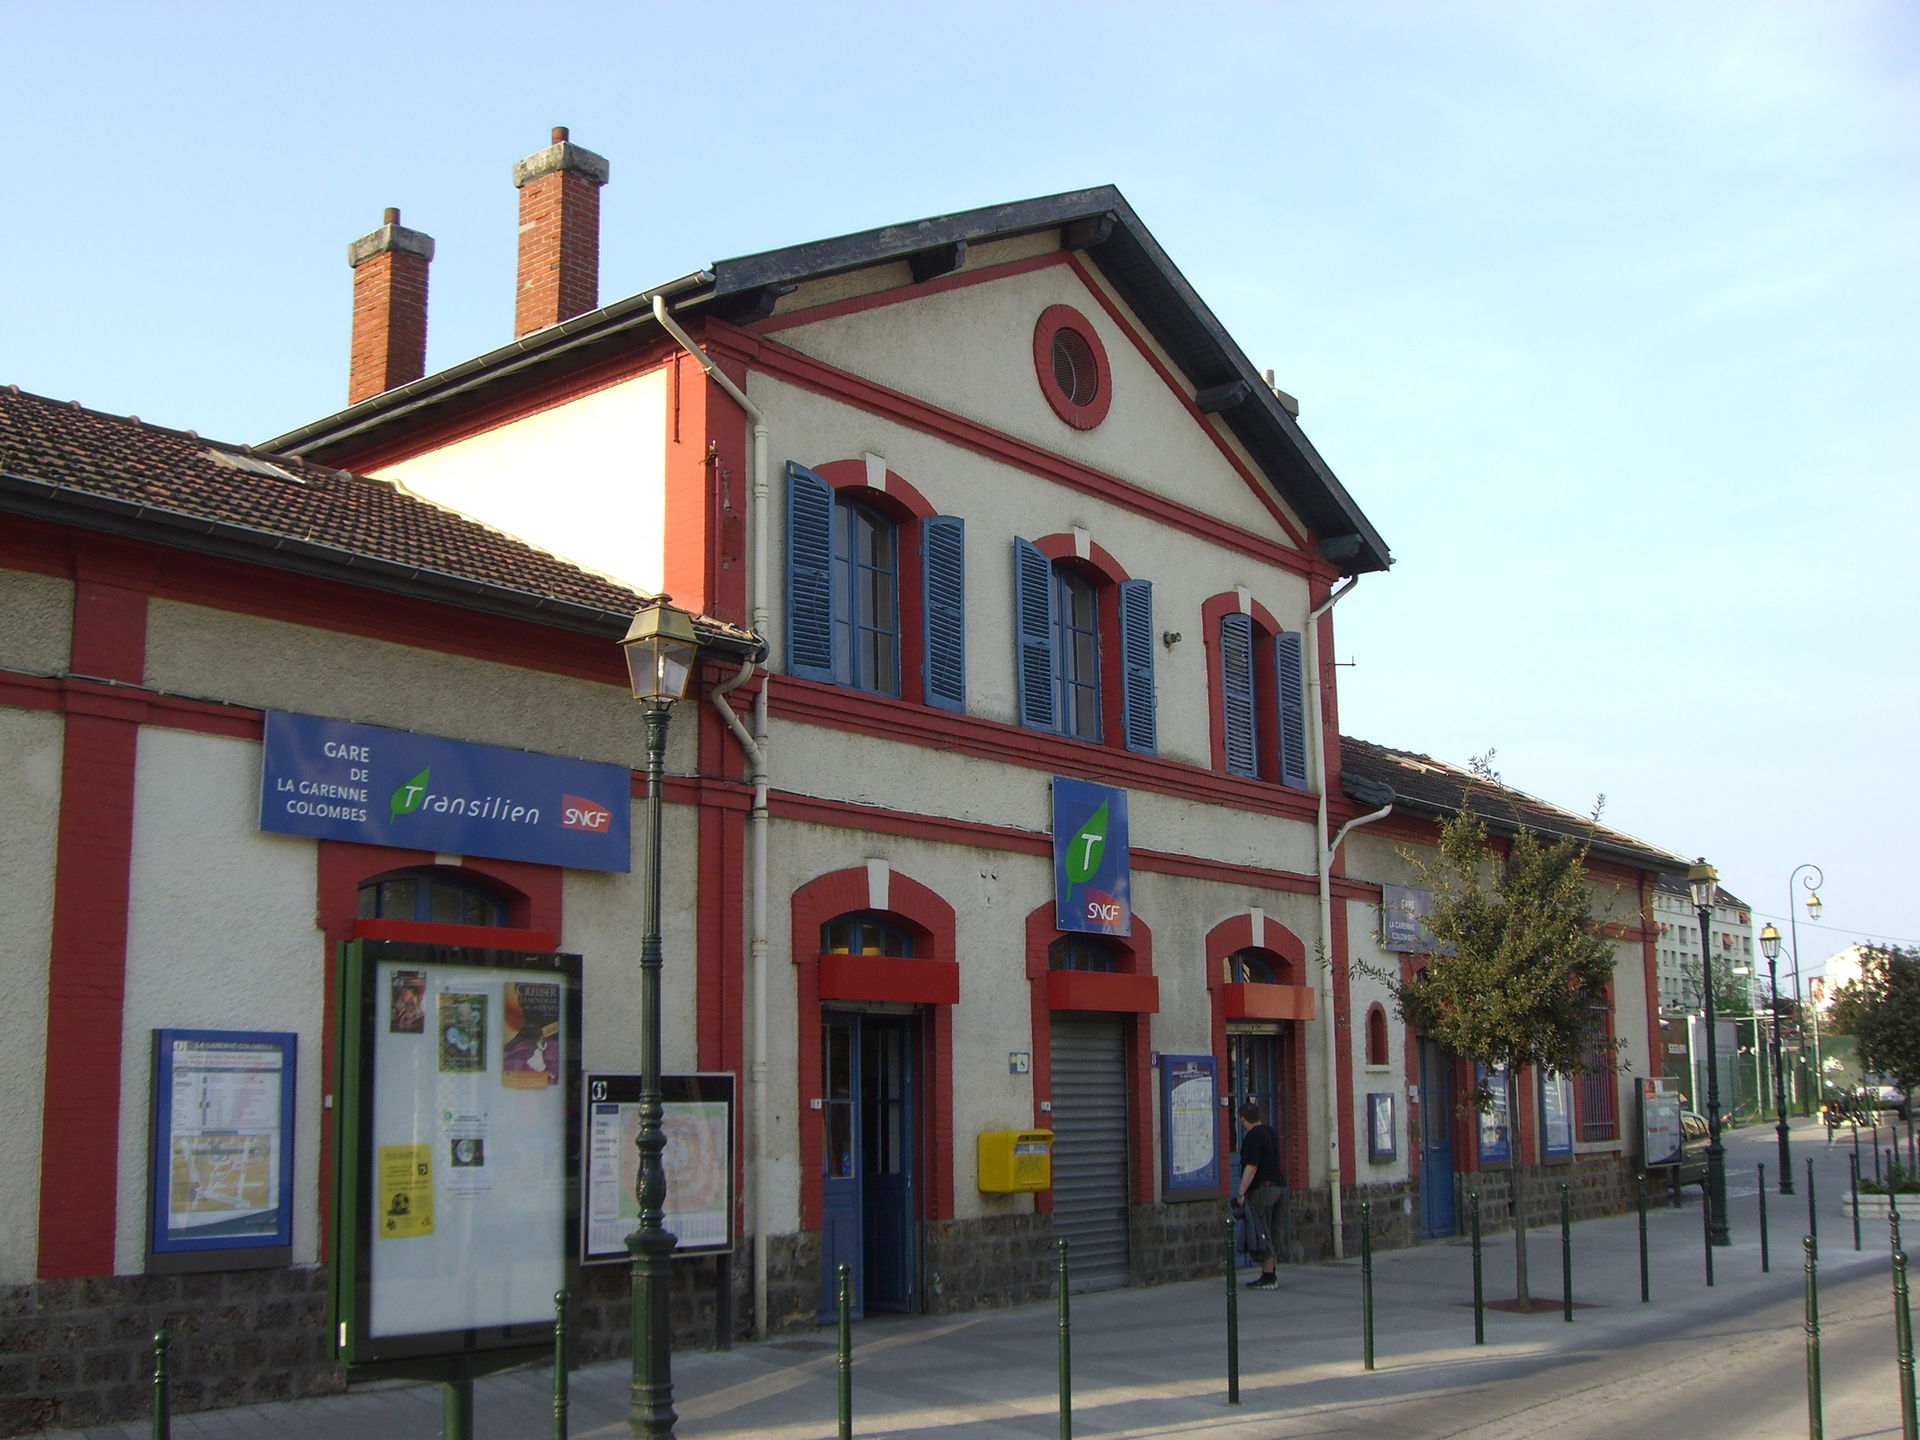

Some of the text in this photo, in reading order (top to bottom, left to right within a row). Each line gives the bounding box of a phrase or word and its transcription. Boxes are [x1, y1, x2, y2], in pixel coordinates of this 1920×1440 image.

[324, 741, 369, 762] GARE
[350, 768, 369, 782] DE
[277, 777, 368, 802] LA GARENNE
[286, 799, 367, 822] COLOMBES
[405, 785, 540, 825] Transilien
[563, 808, 609, 828] SNCF
[1081, 833, 1103, 871] T
[1087, 902, 1120, 921] SNCF
